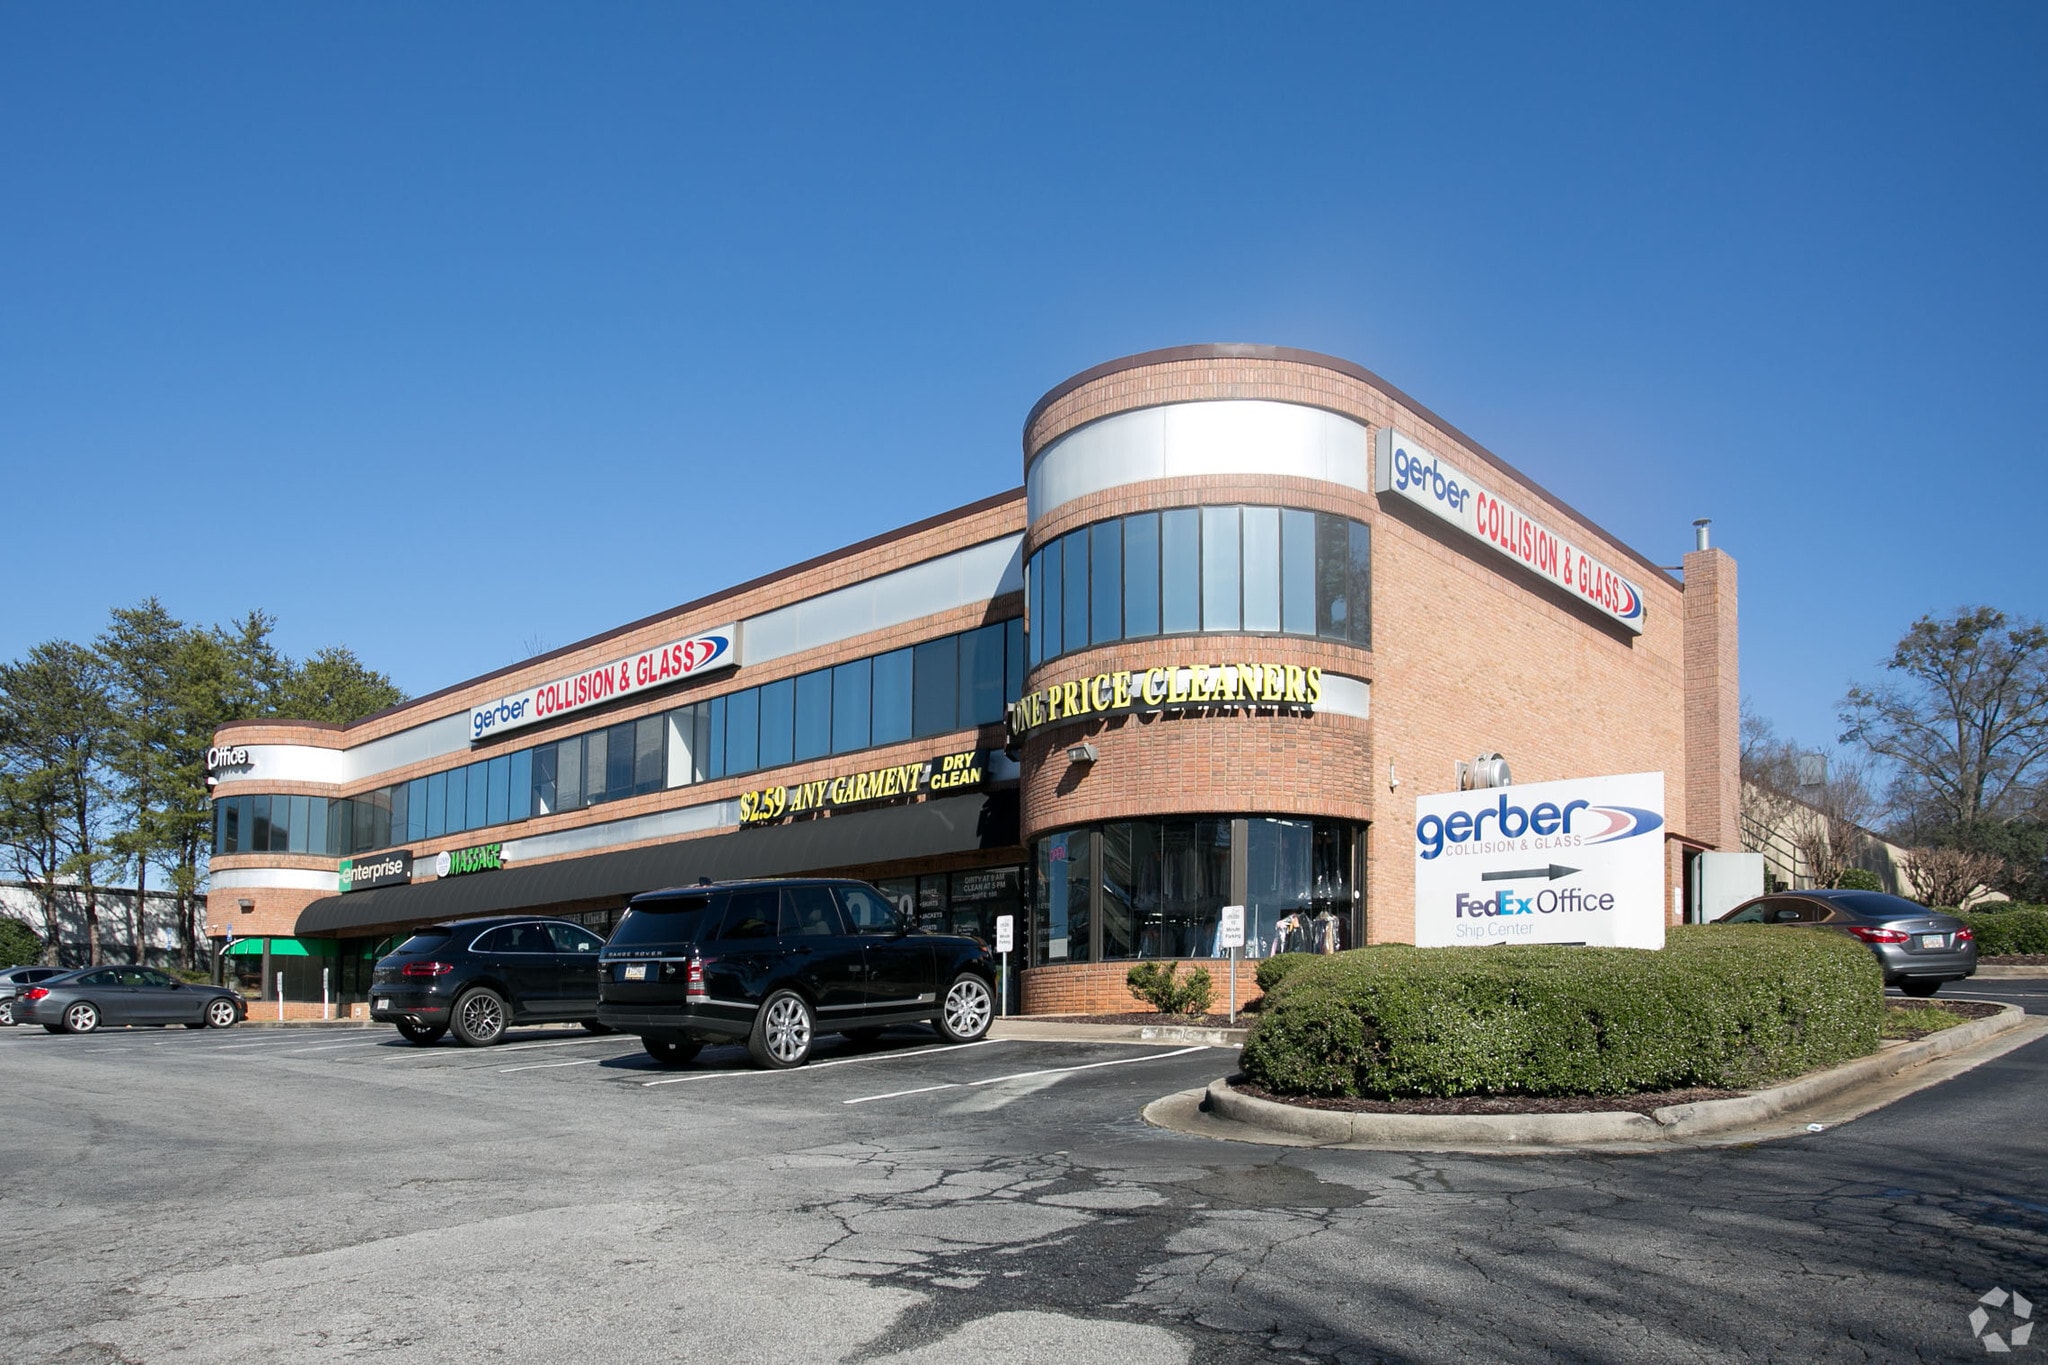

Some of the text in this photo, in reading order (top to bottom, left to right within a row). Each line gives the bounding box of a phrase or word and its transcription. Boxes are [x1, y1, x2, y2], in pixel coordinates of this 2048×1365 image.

[1394, 448, 1619, 614] gerber COLLISION & GLASS
[473, 640, 695, 737] gerber COLLISION & GLASS
[1011, 663, 1323, 735] ONE PRICE CLEANERS
[207, 746, 246, 771] Office
[942, 752, 976, 771] DRY
[740, 762, 923, 822] $2.59 ANY GARMENT
[930, 767, 982, 790] CLEAN
[1416, 793, 1590, 860] gerber
[449, 843, 500, 875] MASSAGE
[1446, 835, 1582, 856] COLLISION & GLASS
[342, 857, 403, 884] enterprise
[963, 883, 983, 892] CLEAN
[1456, 888, 1615, 918] FedEx Office
[1456, 922, 1534, 939] Ship Center
